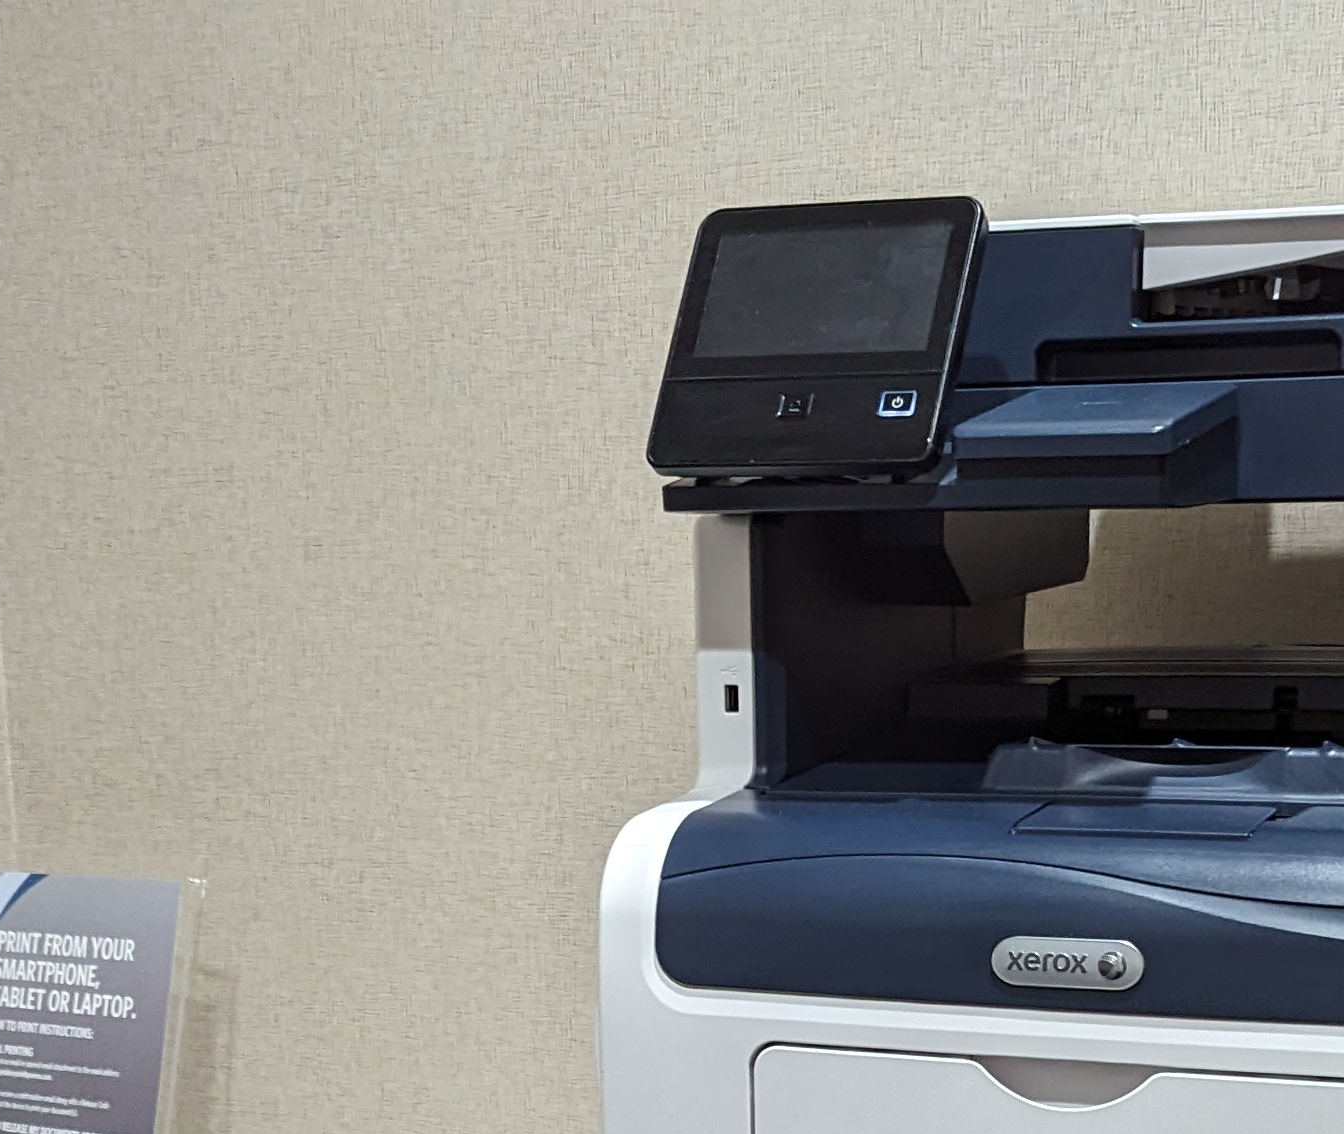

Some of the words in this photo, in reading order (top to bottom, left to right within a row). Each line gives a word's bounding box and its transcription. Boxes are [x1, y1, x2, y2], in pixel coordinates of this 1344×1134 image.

[43, 933, 88, 958] FROM
[91, 936, 135, 961] YOUR
[1007, 950, 1088, 974] xerox
[48, 990, 70, 1013] OR
[72, 992, 136, 1019] LAPTOP.
[6, 1020, 16, 1032] TO
[17, 1021, 39, 1034] PRINT
[2, 1121, 28, 1134] RELEASE
